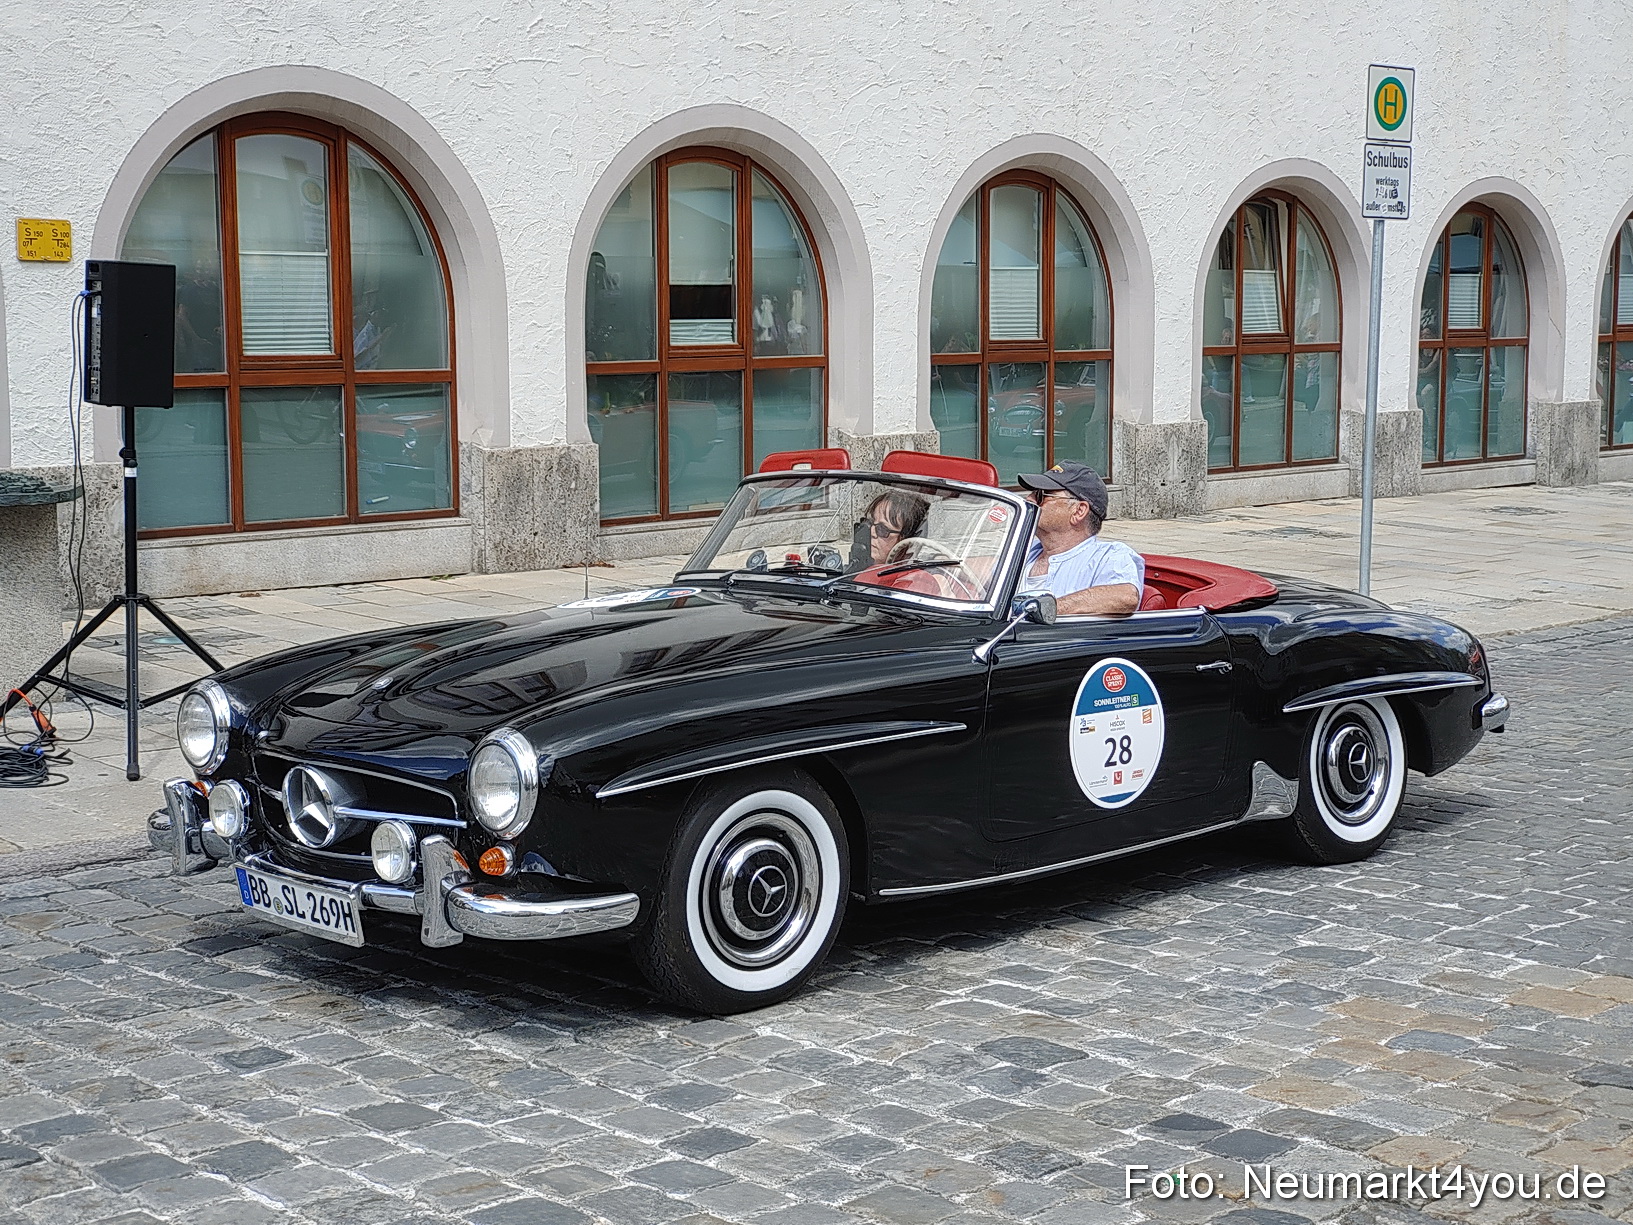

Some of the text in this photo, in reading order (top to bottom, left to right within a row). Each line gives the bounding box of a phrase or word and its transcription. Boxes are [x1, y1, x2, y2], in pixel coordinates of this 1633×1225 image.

[1384, 88, 1398, 119] H
[1366, 151, 1408, 168] Schulbus
[1375, 176, 1399, 188] werktags
[24, 227, 32, 237] S
[51, 228, 59, 238] S
[1104, 734, 1132, 768] 28
[248, 874, 356, 933] BB SL 269H
